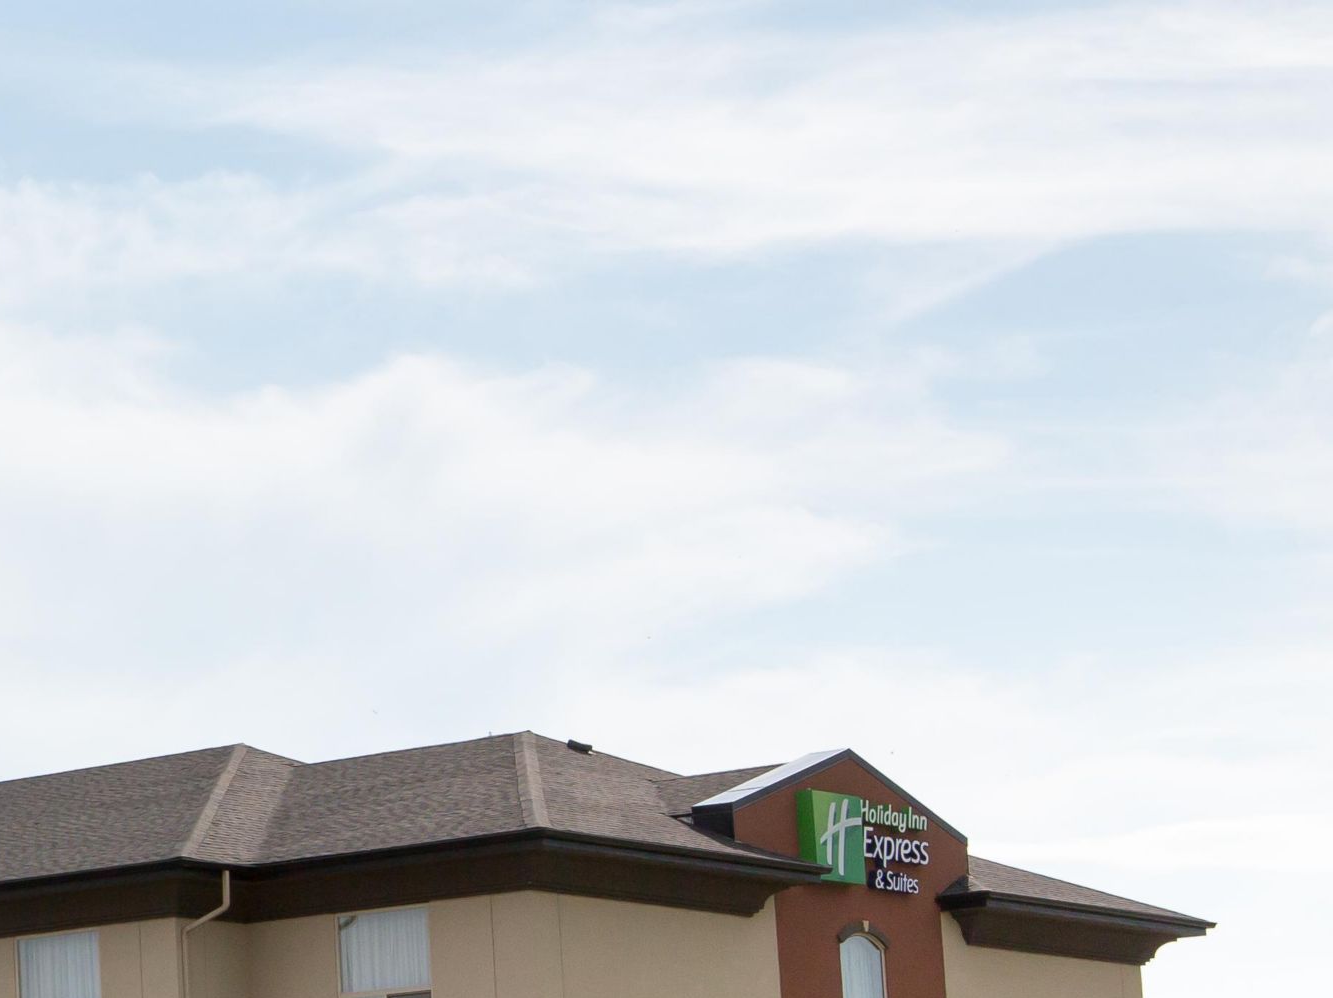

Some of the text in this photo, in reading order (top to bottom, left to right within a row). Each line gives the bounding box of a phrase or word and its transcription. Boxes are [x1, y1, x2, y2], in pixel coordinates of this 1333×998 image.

[860, 799, 928, 833] Holiday Inn
[863, 826, 930, 868] Express
[875, 869, 919, 894] & Suites
